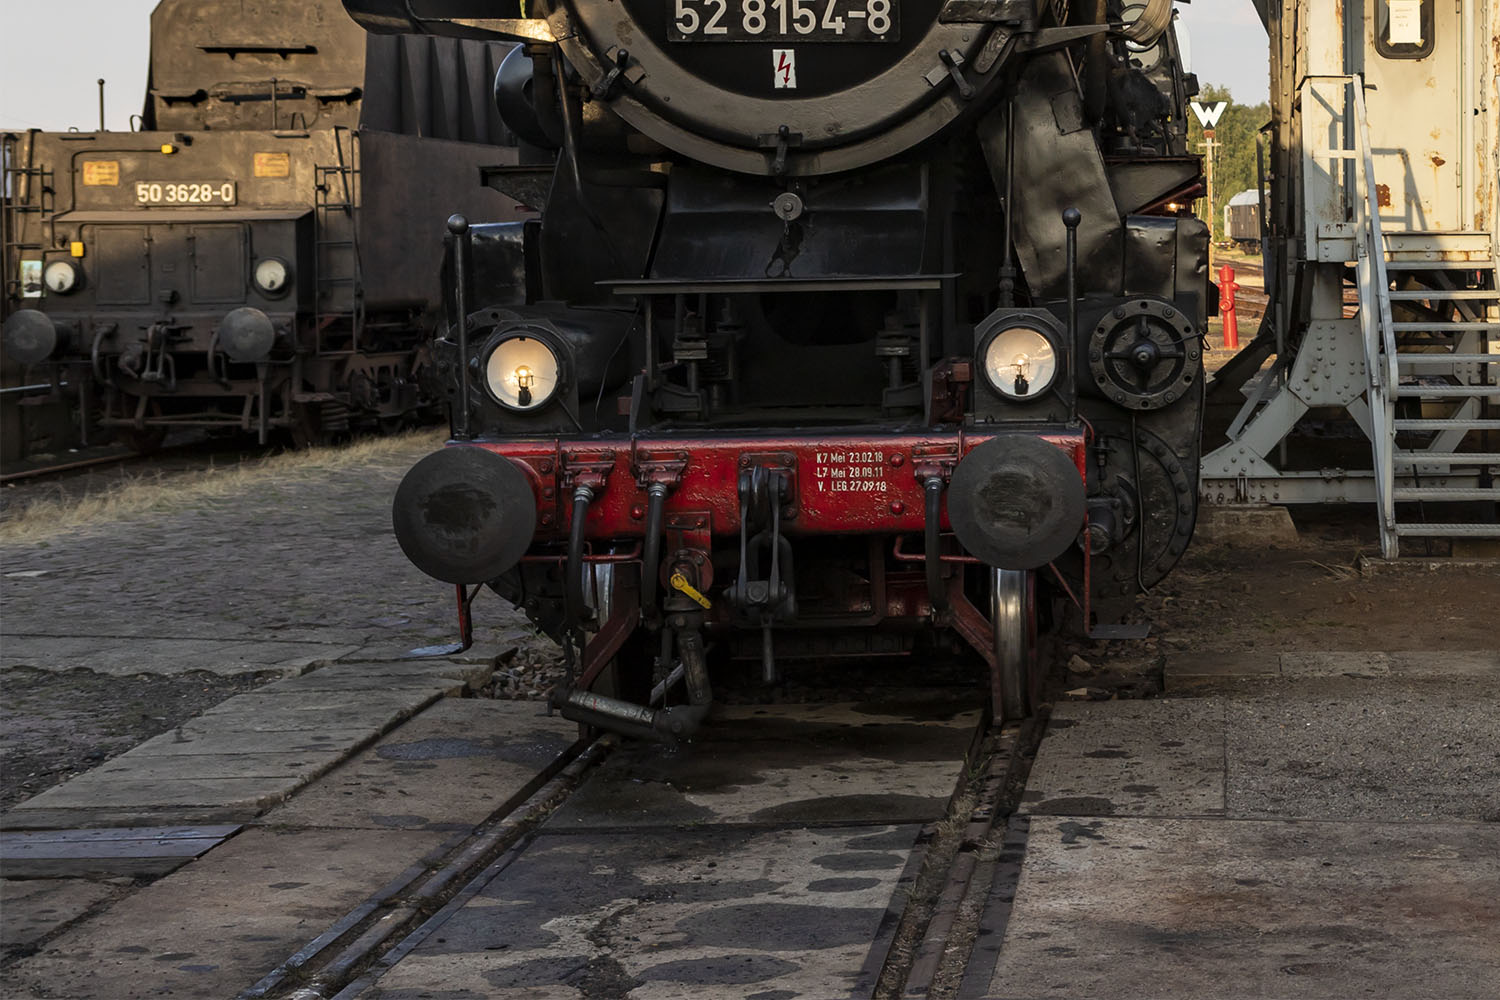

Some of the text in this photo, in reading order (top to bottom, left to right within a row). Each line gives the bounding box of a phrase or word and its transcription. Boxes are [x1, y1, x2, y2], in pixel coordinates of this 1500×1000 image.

[1190, 101, 1228, 128] W
[137, 184, 233, 203] 50 3628-0
[830, 452, 846, 463] Mei
[849, 451, 883, 463] 23.02.18
[831, 467, 846, 478] Mei
[849, 467, 883, 478] 28.09.11
[849, 481, 887, 492] 27.09.18
